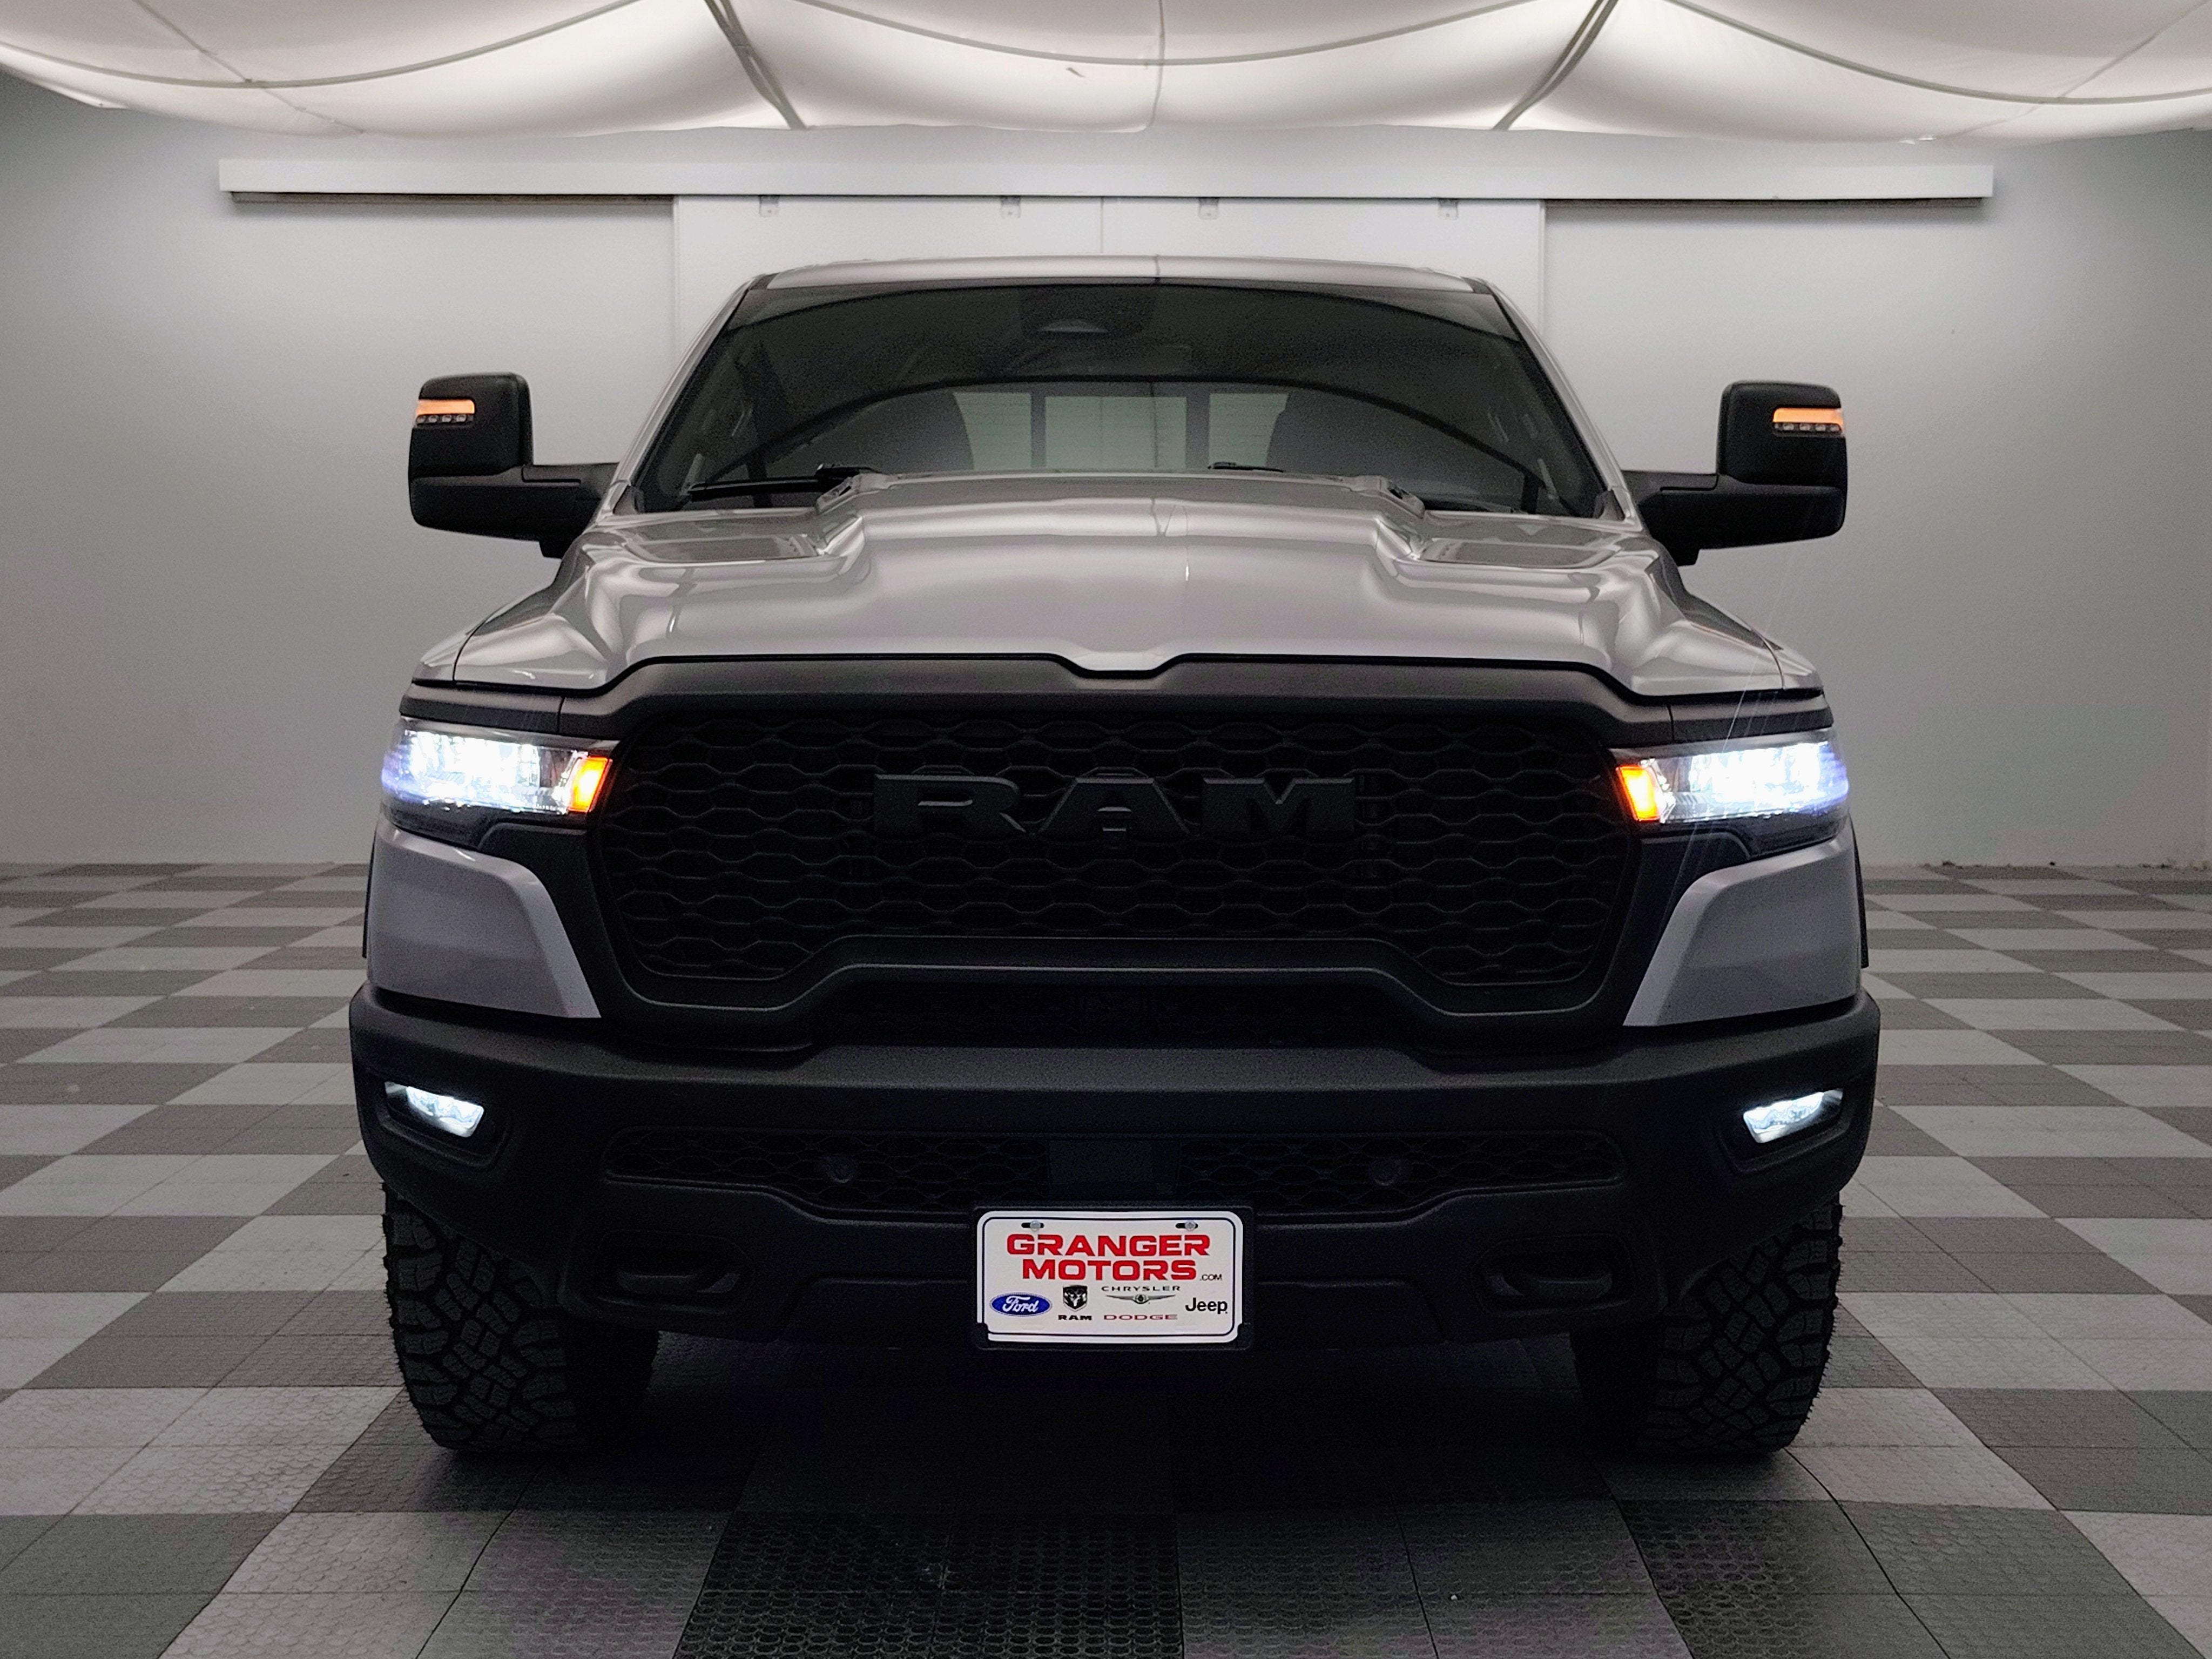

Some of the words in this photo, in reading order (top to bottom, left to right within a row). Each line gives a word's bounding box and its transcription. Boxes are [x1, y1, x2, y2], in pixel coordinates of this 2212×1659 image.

[873, 773, 1355, 837] RAM
[1007, 1233, 1210, 1257] GRANGER
[1022, 1259, 1197, 1281] MOTORS
[1002, 1296, 1039, 1312] Ford
[1185, 1297, 1228, 1314] Jeep
